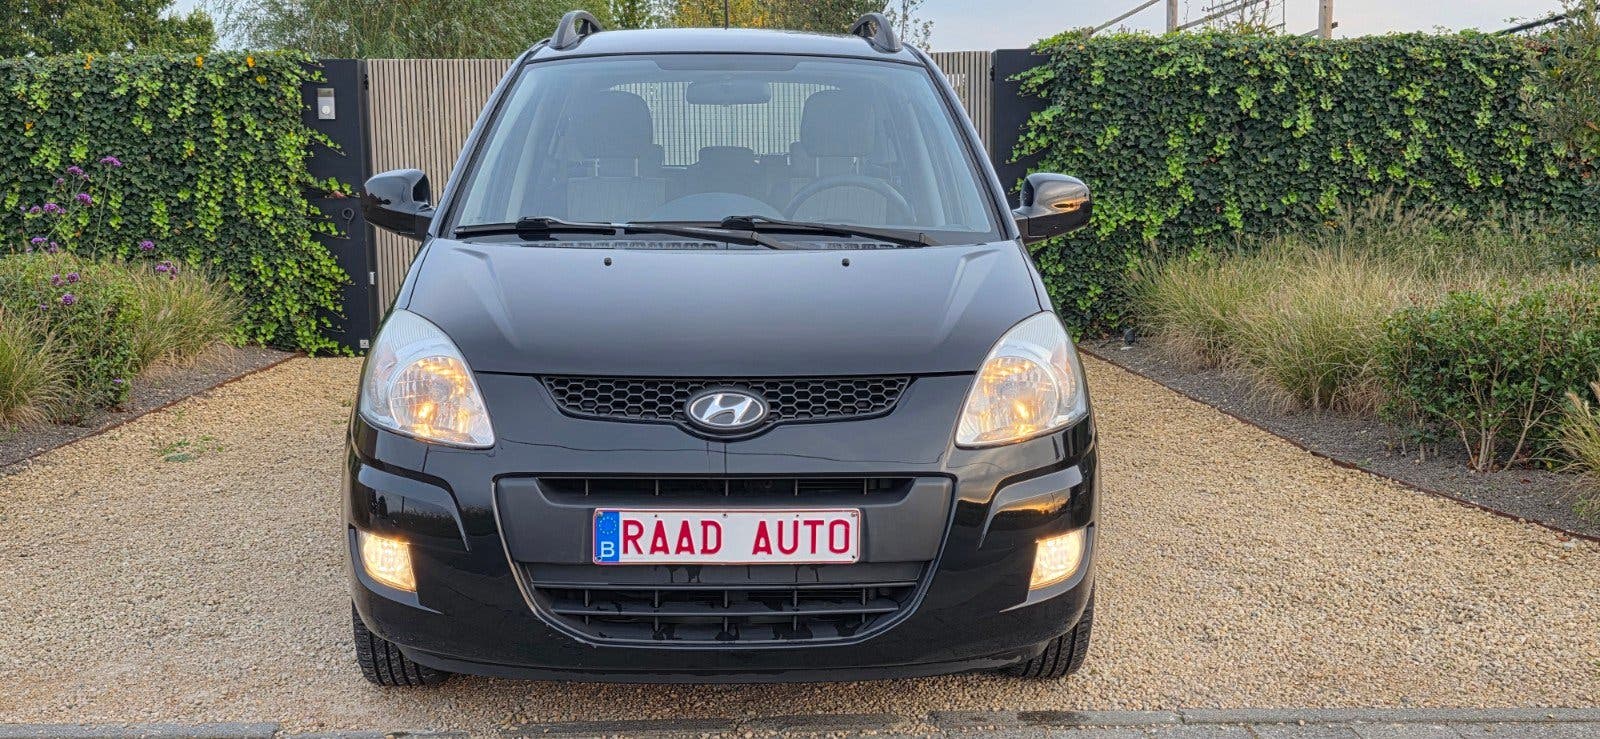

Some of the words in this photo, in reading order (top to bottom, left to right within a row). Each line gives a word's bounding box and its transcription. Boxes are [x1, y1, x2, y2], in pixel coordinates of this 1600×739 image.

[600, 541, 615, 558] B
[622, 520, 722, 555] RAAD
[752, 519, 850, 555] AUTO
